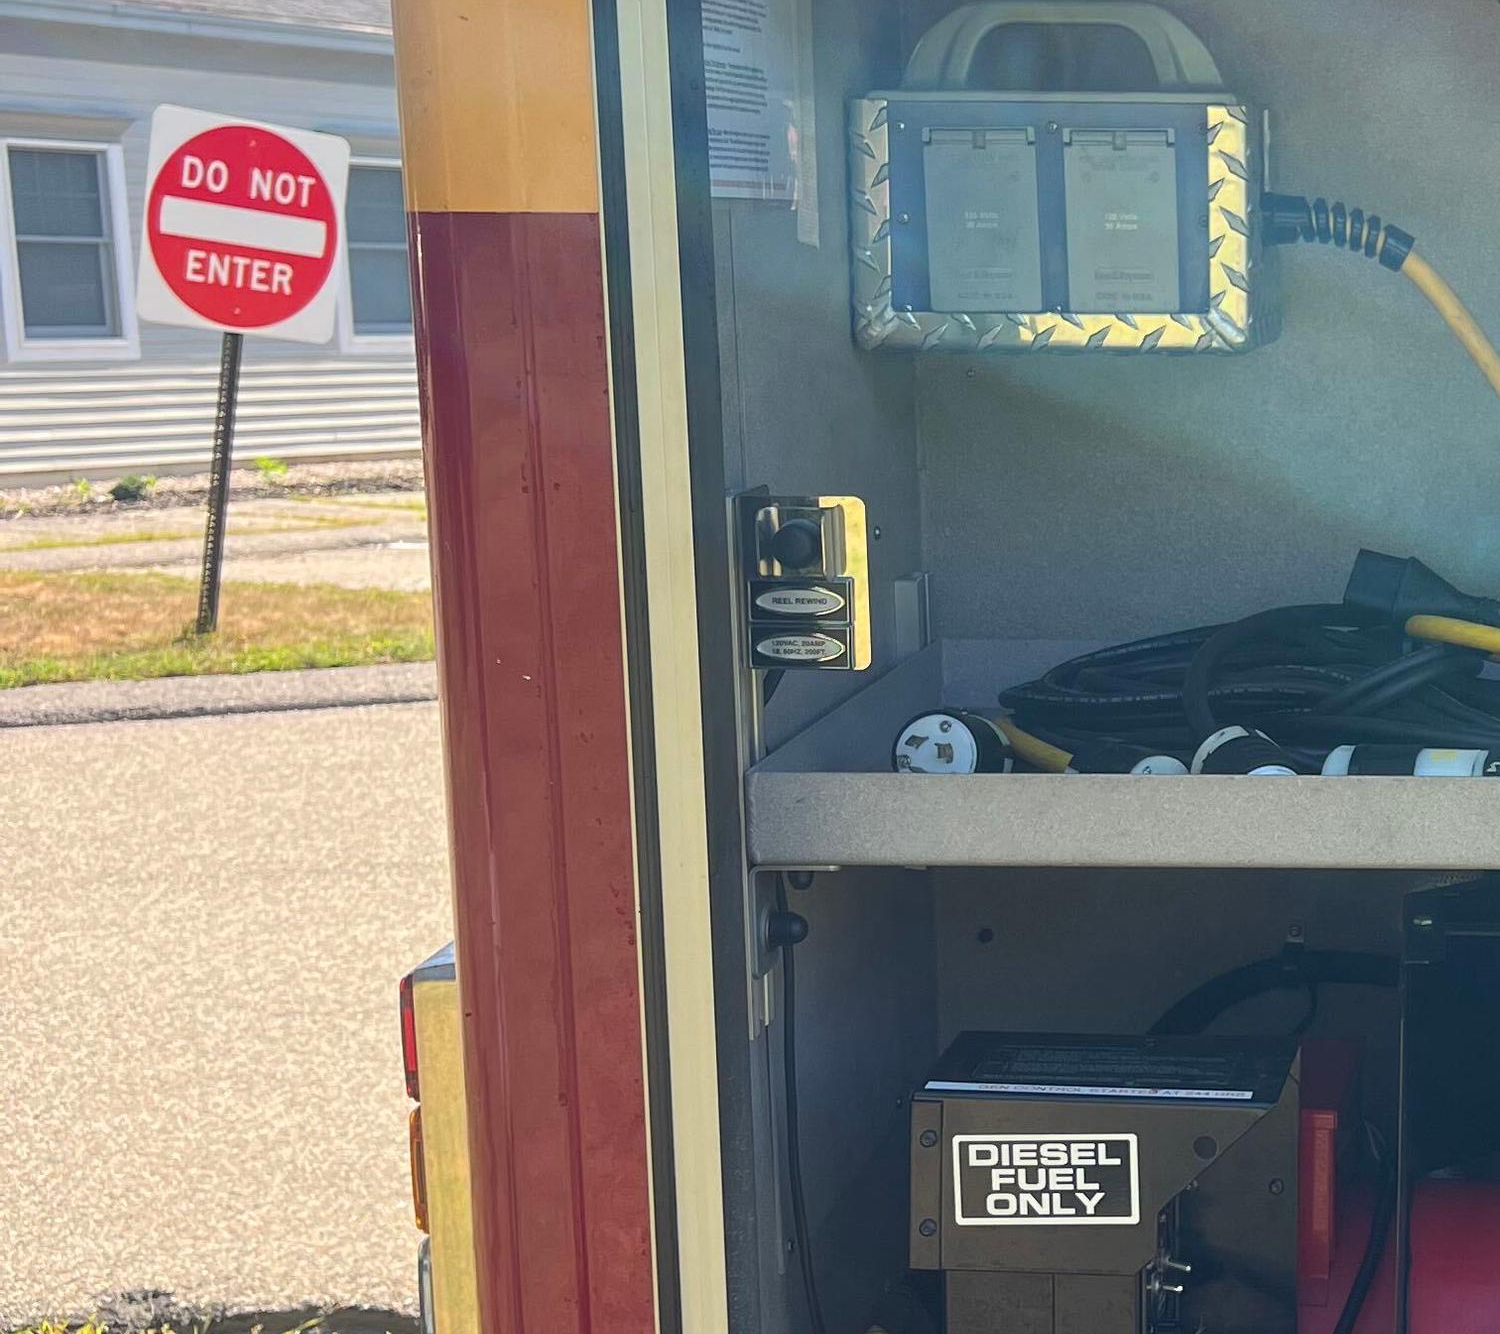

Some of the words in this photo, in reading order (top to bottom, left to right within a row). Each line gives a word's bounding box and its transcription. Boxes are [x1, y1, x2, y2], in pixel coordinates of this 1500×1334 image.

[181, 154, 229, 194] DO
[250, 167, 317, 208] NOT
[184, 248, 295, 296] ENTER
[771, 597, 794, 605] REEL
[795, 597, 828, 605] REWIND
[968, 1142, 1121, 1167] DIESEL
[991, 1167, 1100, 1191] FUEL
[986, 1192, 1106, 1216] ONLY
